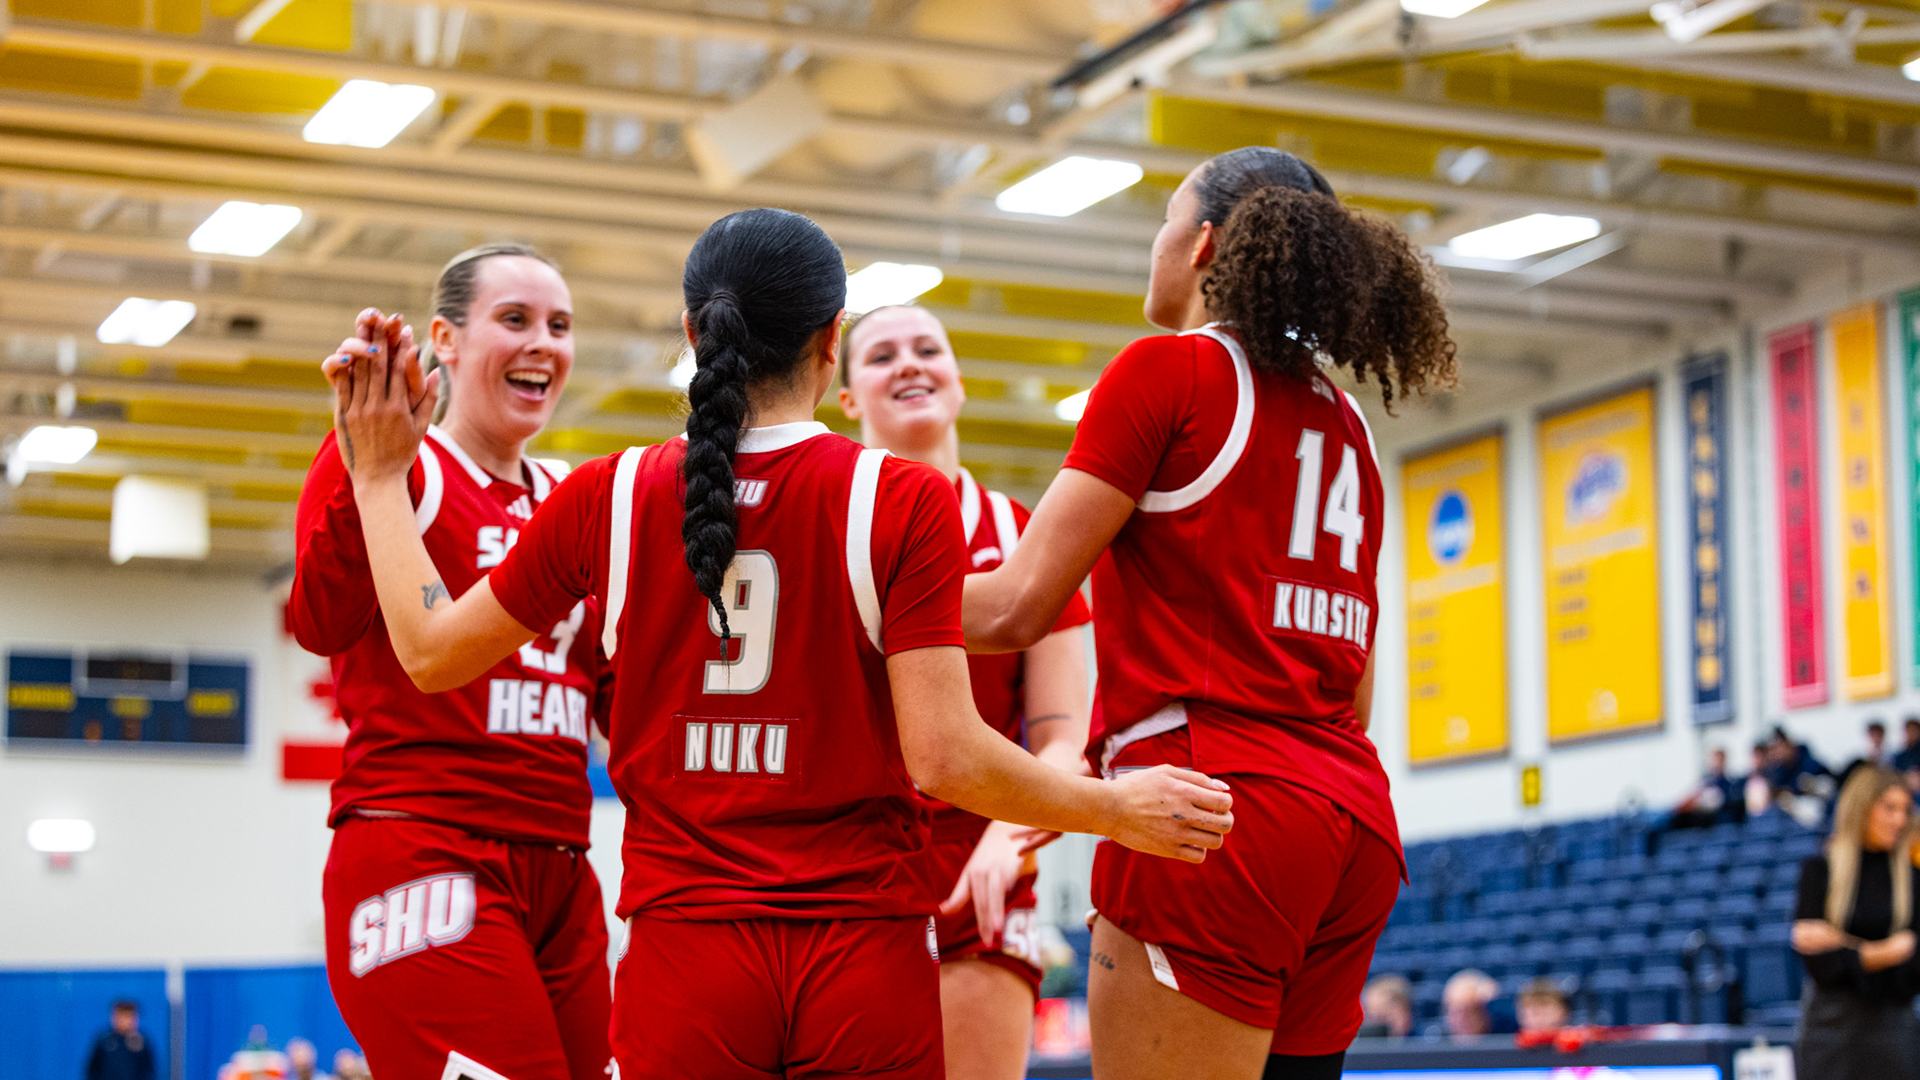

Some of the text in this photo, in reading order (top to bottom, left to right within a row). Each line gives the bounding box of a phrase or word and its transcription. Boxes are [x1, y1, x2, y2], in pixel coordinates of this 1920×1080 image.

[1288, 428, 1364, 573] 14
[702, 549, 780, 695] 9
[685, 722, 788, 774] NUKU
[349, 872, 476, 978] SHU
